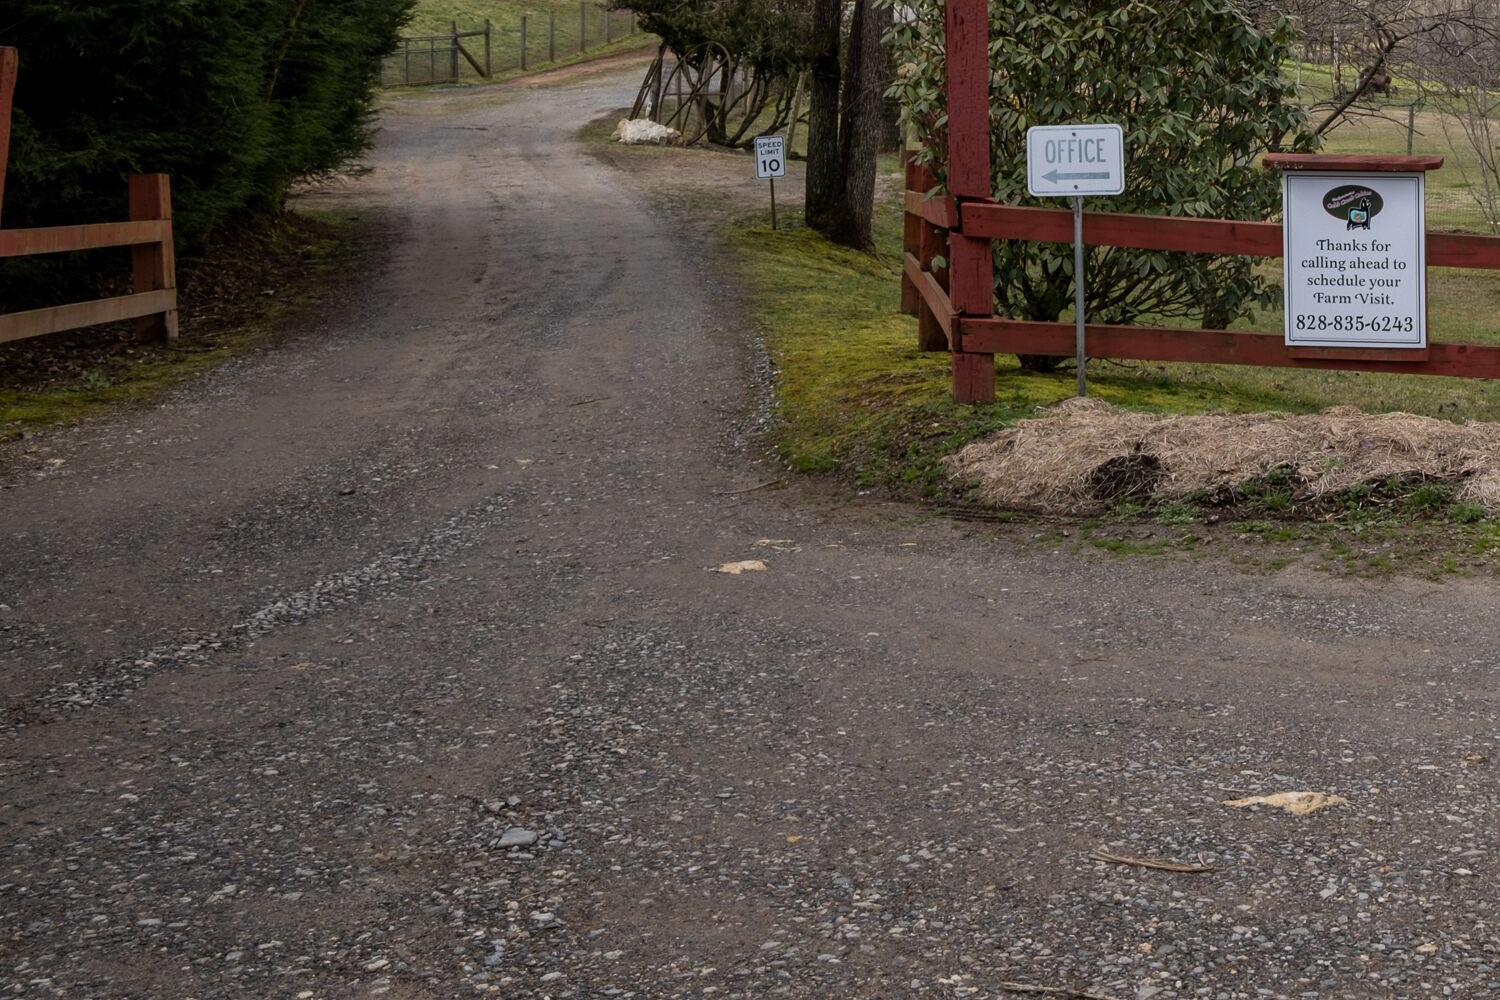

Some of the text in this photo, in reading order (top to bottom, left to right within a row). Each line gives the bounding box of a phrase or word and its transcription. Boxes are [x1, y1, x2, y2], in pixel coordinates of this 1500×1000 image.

[1045, 138, 1106, 164] OFFICE
[762, 158, 780, 172] 10
[1316, 239, 1391, 252] Thanks for
[1301, 257, 1407, 271] calling ahead to
[1307, 274, 1401, 290] schedule your
[1313, 292, 1394, 305] Farm Visit.
[1296, 314, 1413, 332] 828-835-6243
